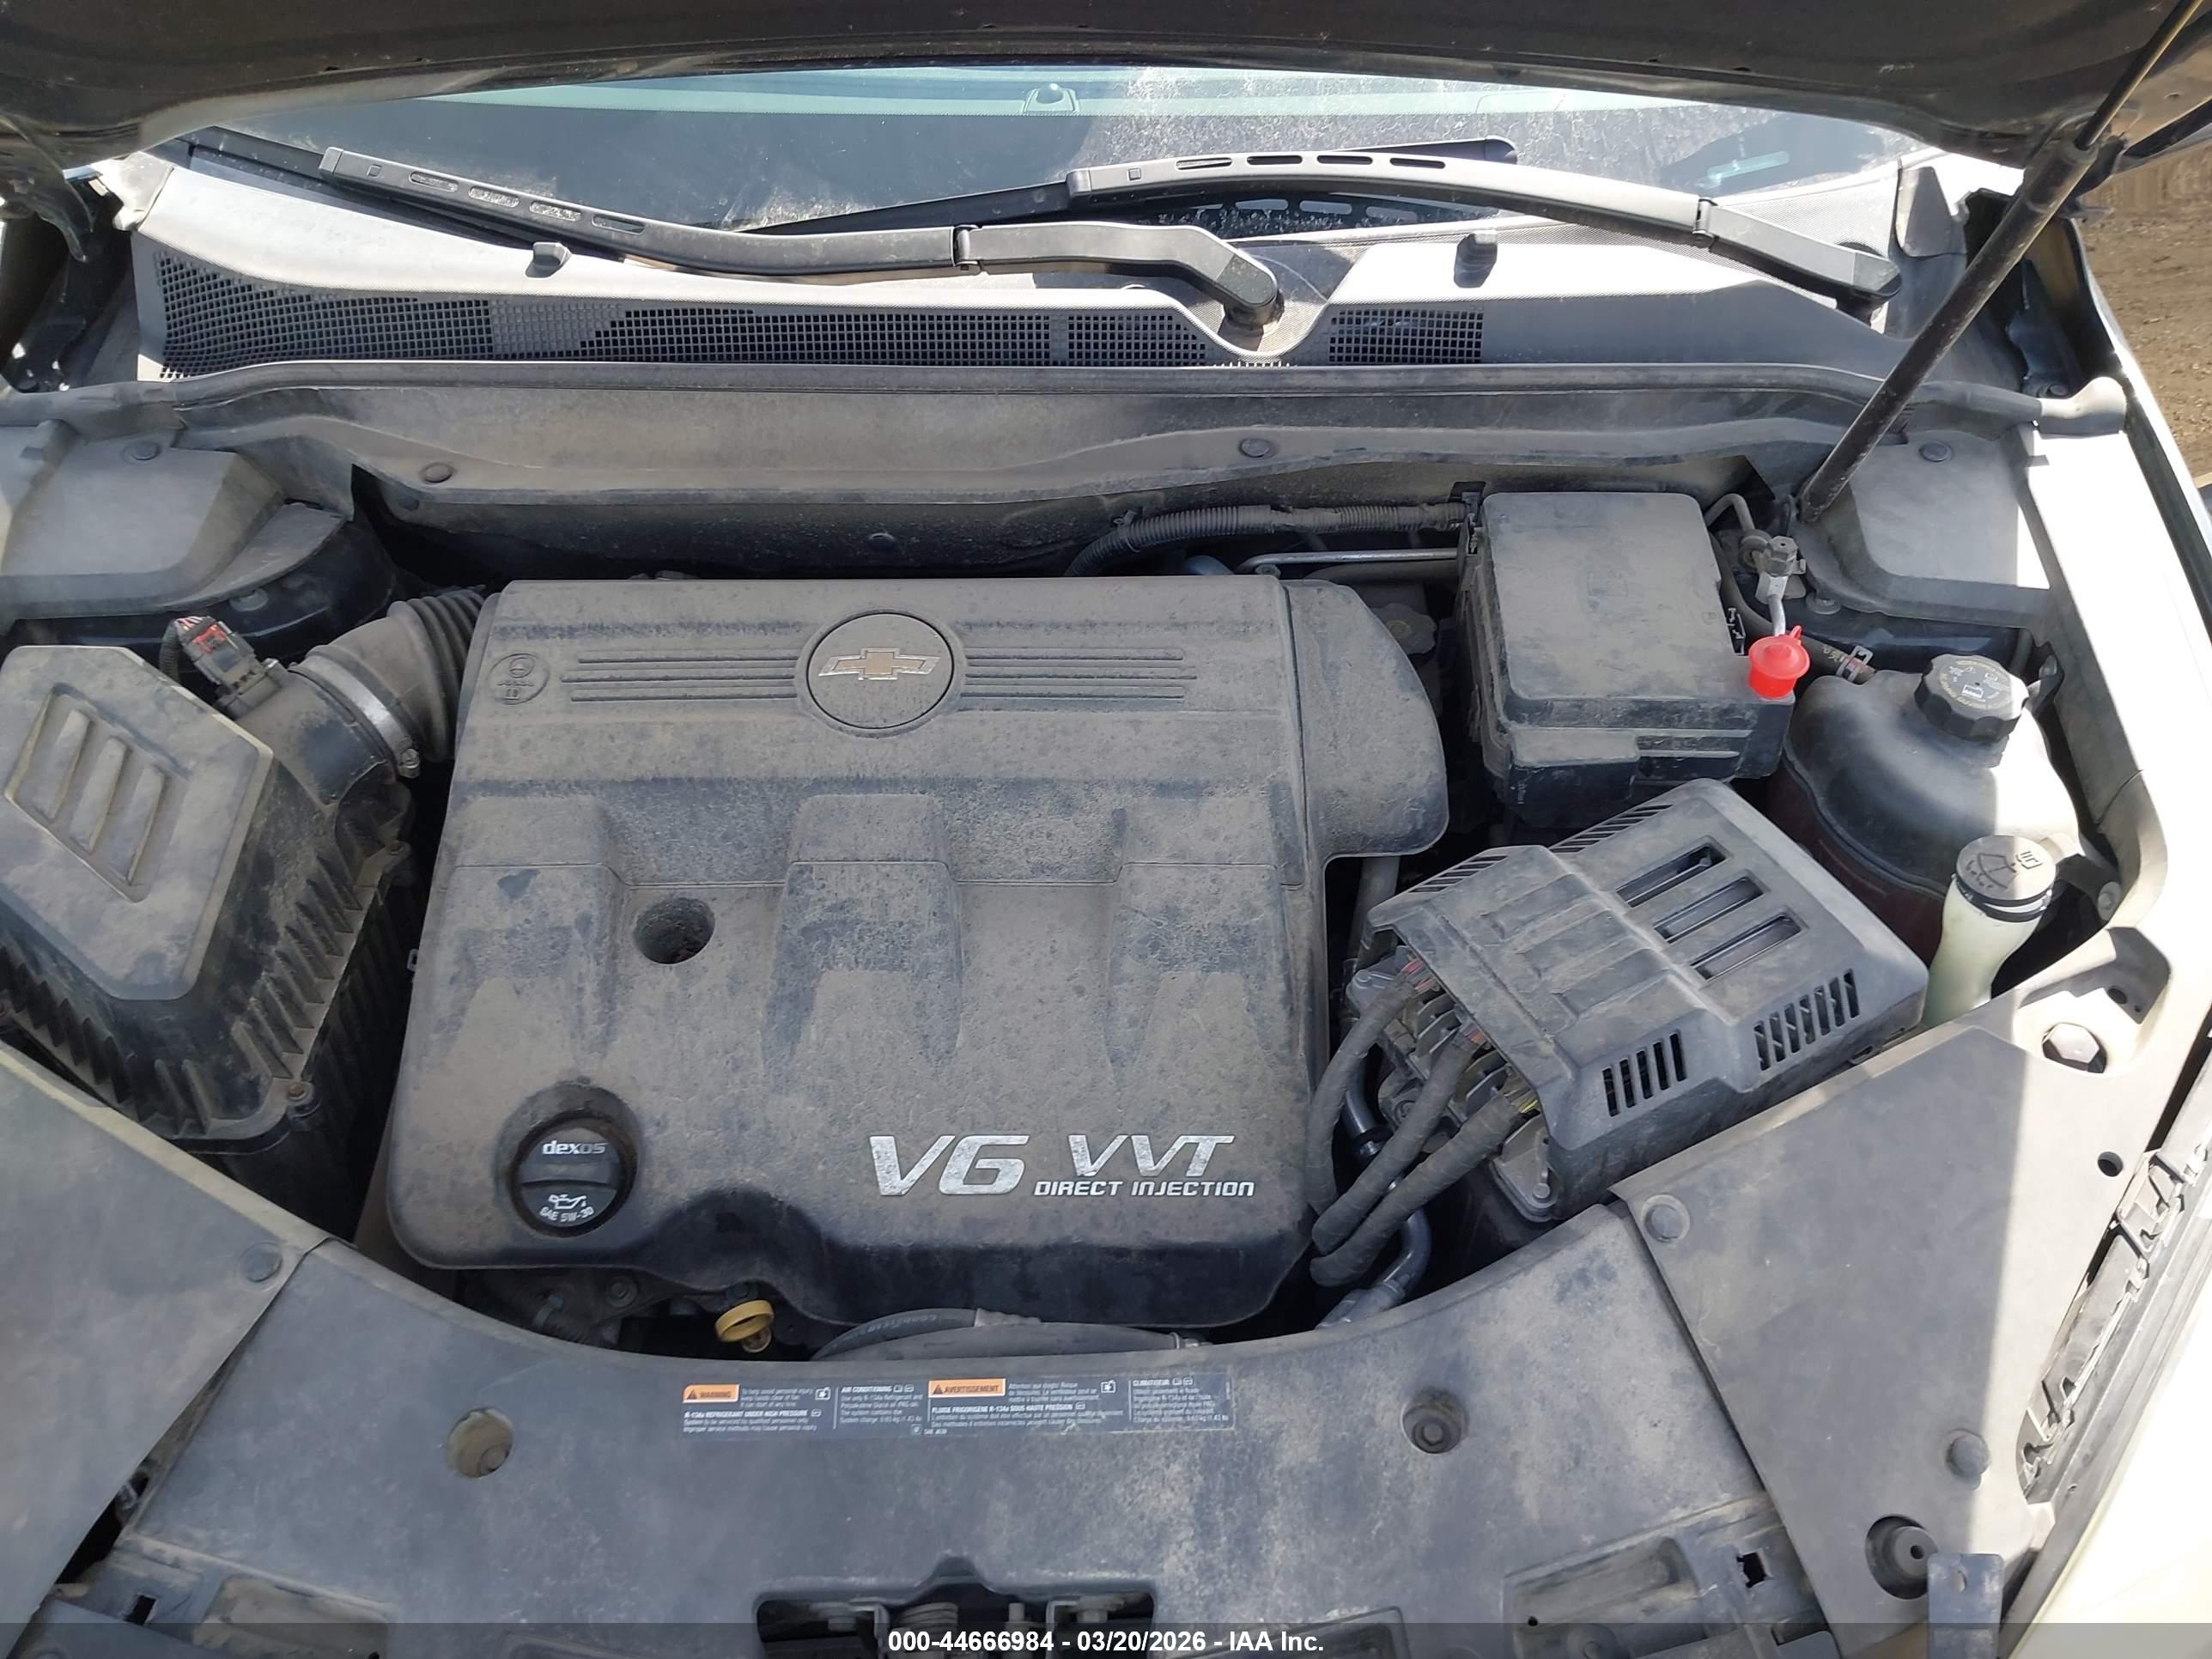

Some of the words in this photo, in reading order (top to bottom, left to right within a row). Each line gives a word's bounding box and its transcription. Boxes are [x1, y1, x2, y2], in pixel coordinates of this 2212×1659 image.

[543, 1140, 609, 1155] dexos
[869, 1134, 1030, 1196] V6
[1068, 1134, 1235, 1177] VVT
[1034, 1181, 1123, 1196] DIRECT
[1131, 1181, 1255, 1196] INJECTION
[539, 1206, 559, 1221] SAE
[560, 1206, 594, 1223] 5W-30
[944, 1384, 1000, 1393] AVERTISSEMENT
